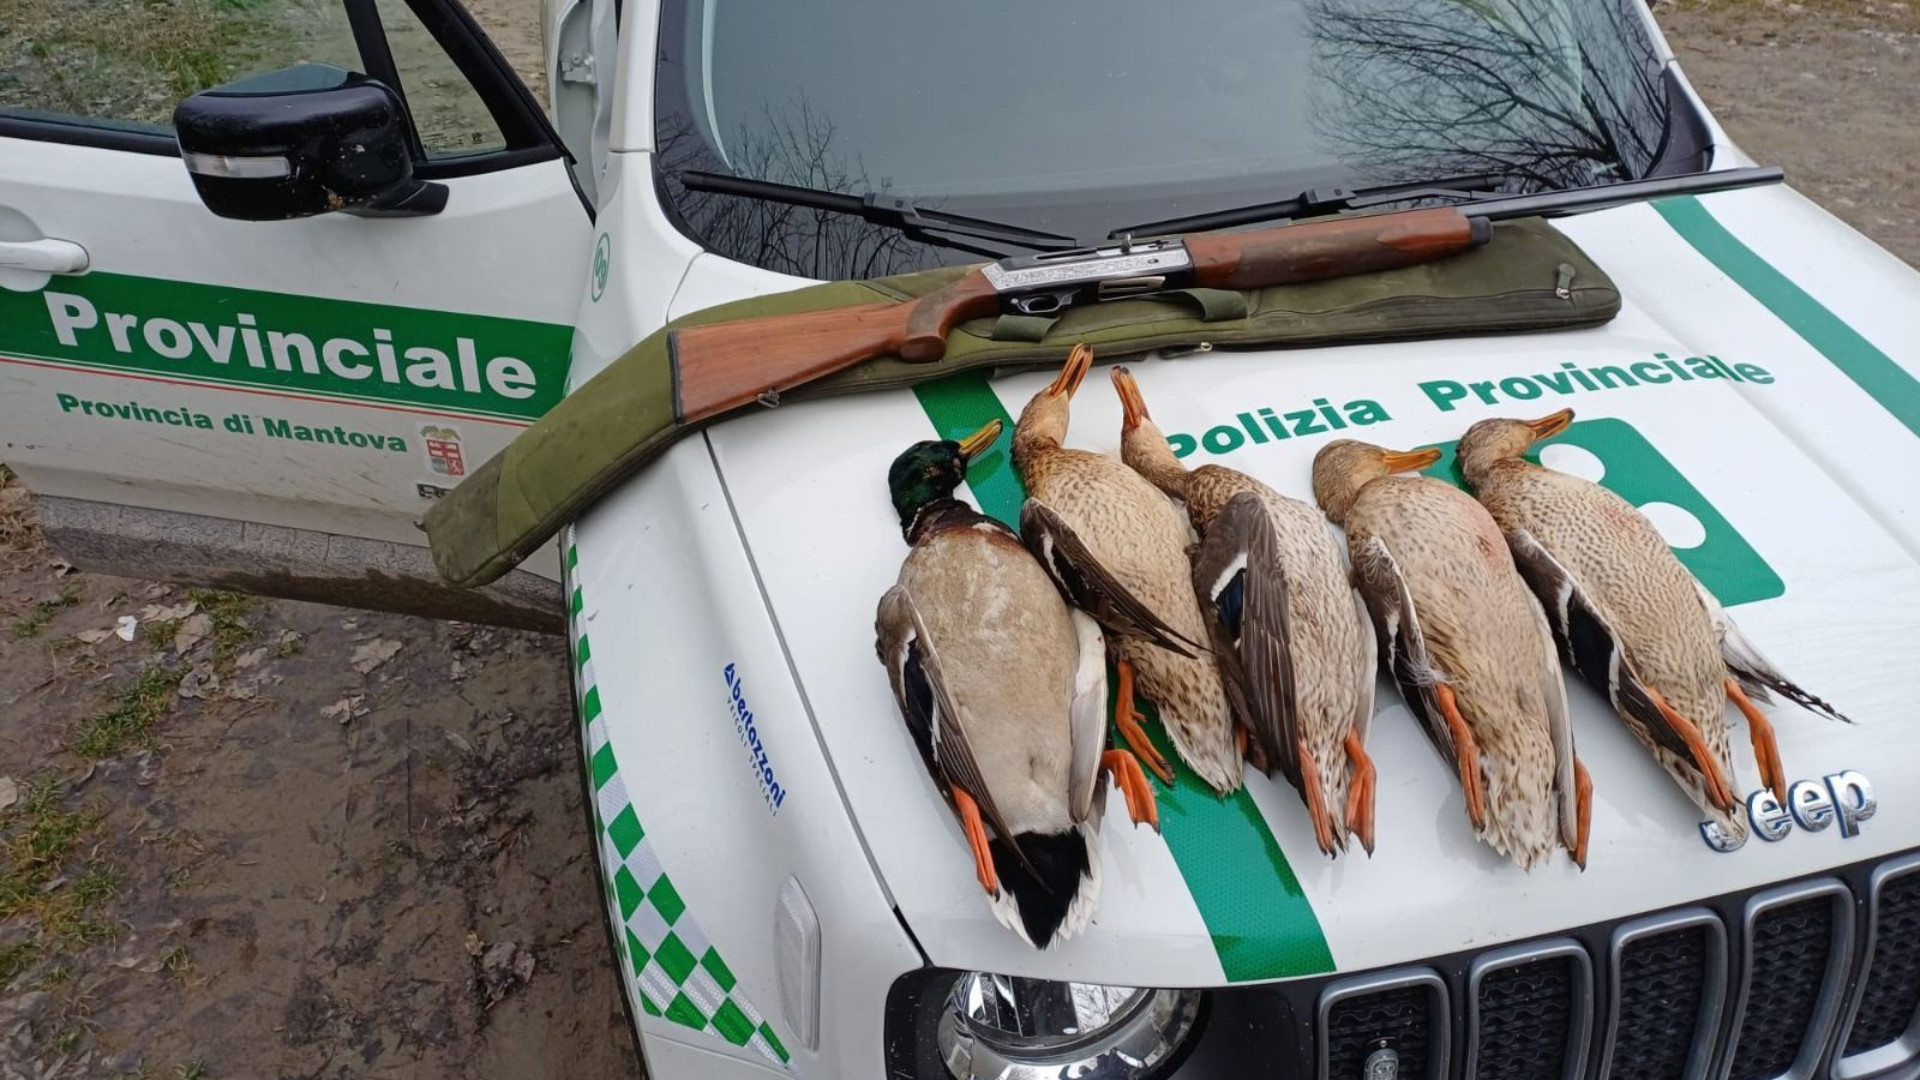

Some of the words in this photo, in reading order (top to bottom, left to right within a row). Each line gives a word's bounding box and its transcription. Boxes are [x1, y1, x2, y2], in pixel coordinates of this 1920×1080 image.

[44, 291, 537, 399] Provinciale
[1417, 353, 1775, 412] Provinciale
[56, 392, 214, 430] Provincia
[223, 414, 254, 434] di
[262, 417, 408, 452] Mantova
[732, 678, 786, 808] bertazzoni
